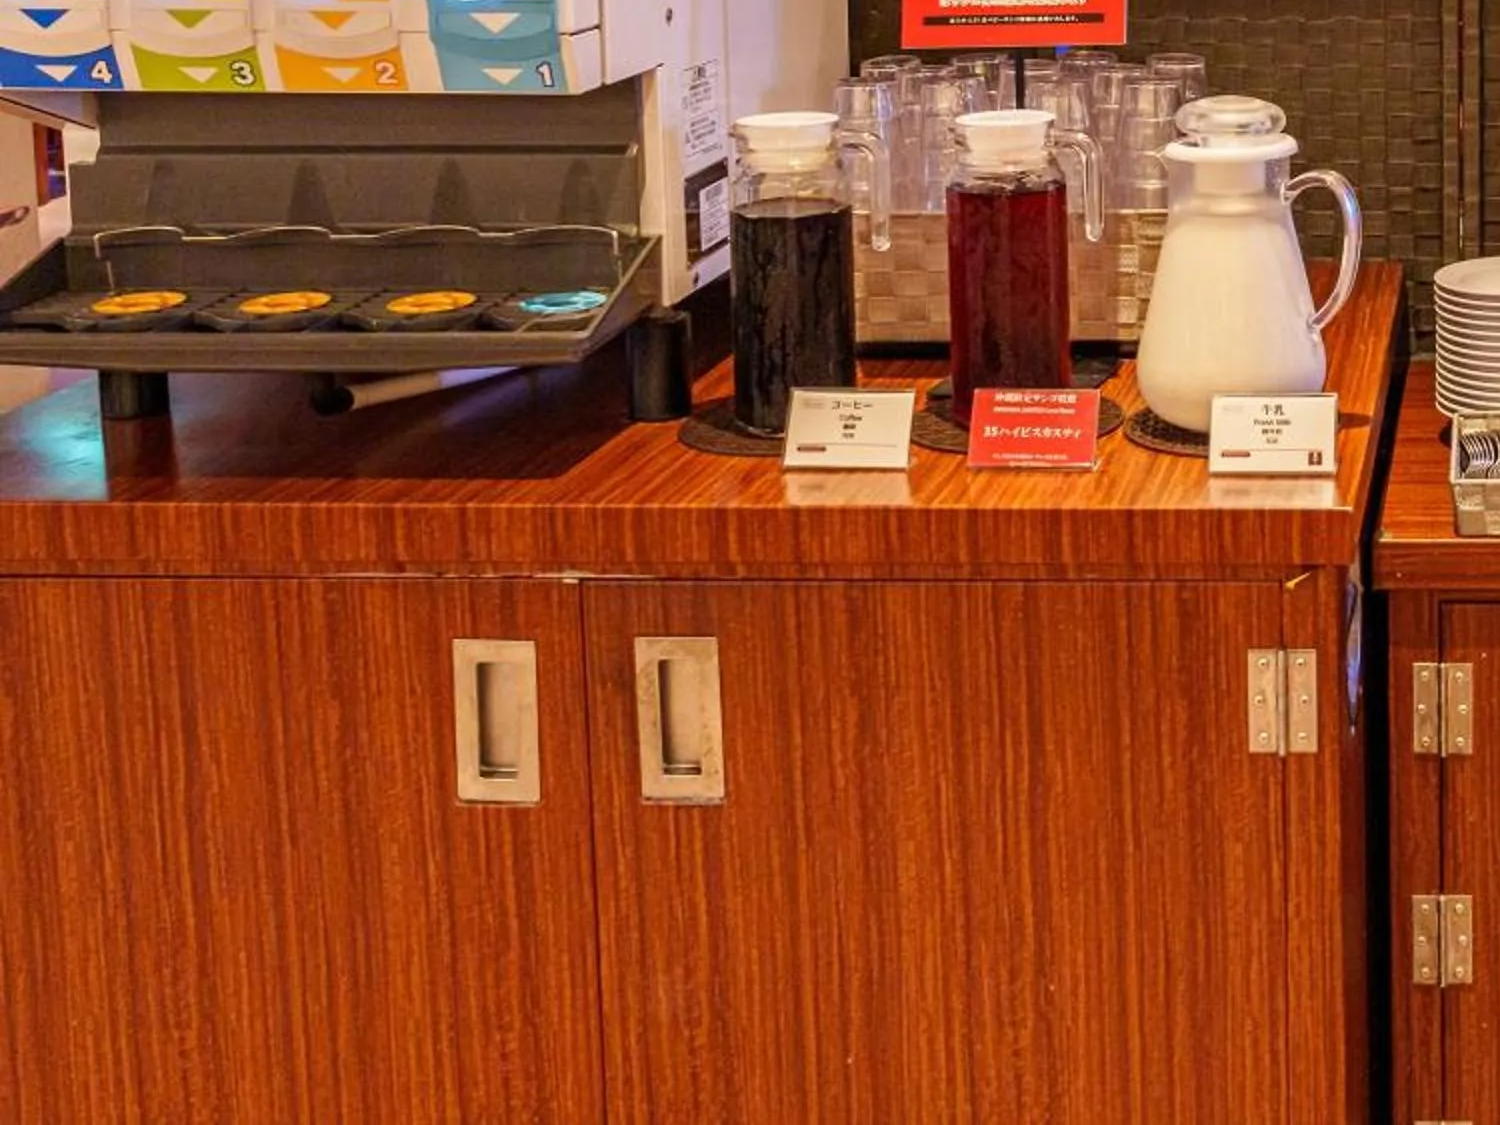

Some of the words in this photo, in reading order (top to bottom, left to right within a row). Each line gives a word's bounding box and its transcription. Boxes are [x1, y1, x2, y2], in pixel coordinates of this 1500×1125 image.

[91, 60, 113, 84] 4
[229, 60, 256, 86] 3
[374, 60, 399, 85] 2
[536, 61, 555, 87] 1
[831, 400, 873, 410] コーヒー
